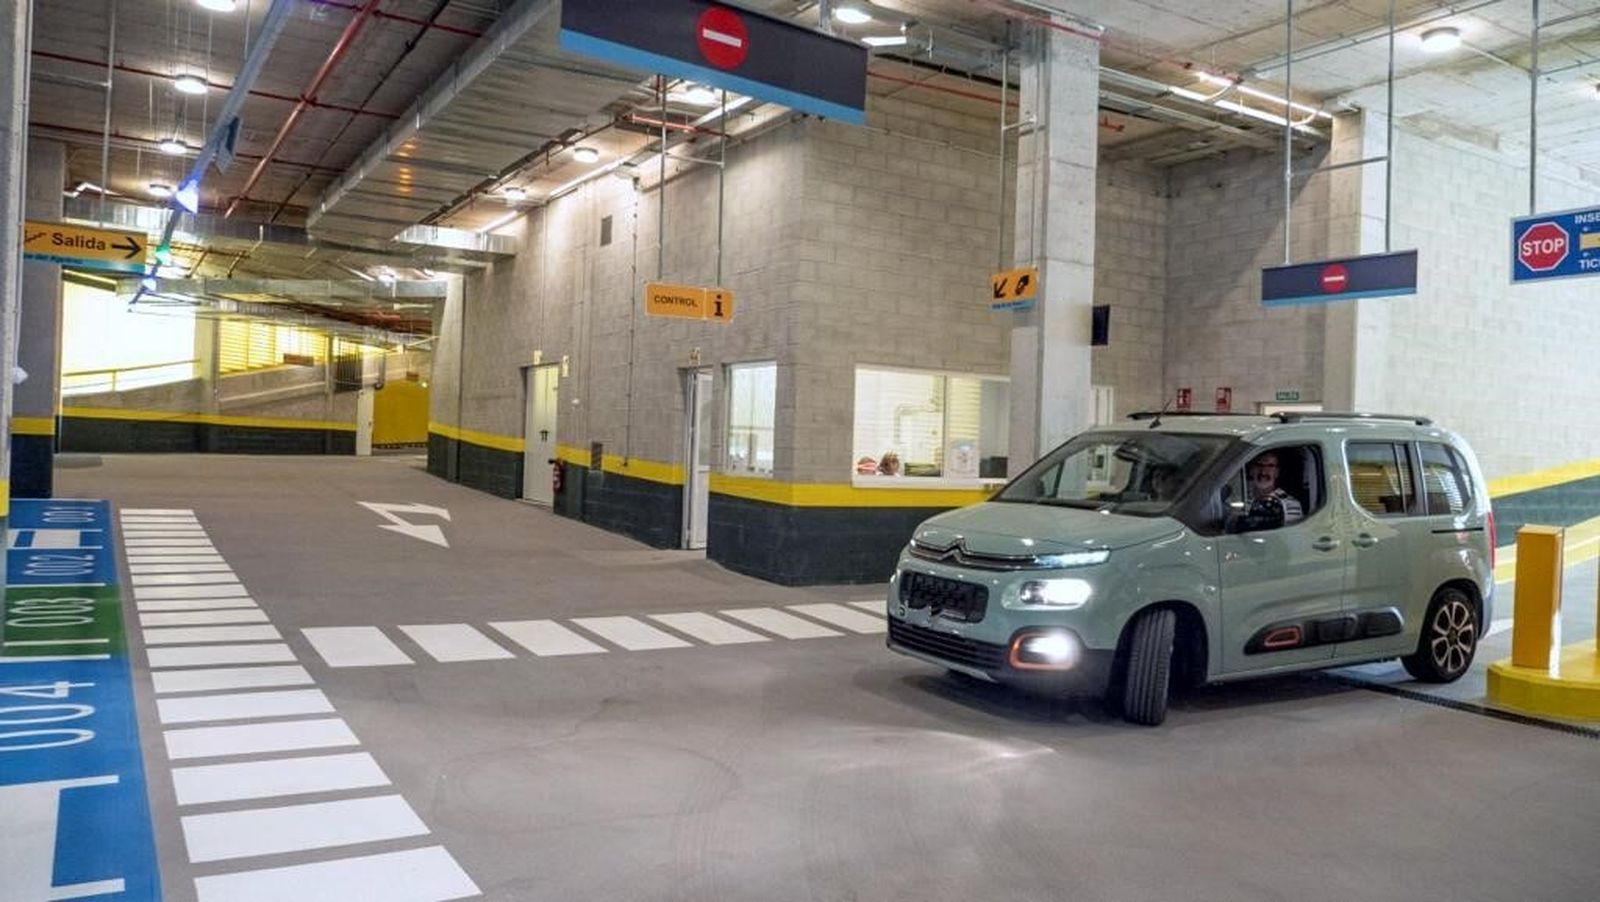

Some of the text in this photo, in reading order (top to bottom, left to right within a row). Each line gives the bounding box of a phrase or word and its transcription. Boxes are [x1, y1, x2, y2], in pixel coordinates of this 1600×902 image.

[51, 232, 106, 251] Salida
[1522, 238, 1565, 257] STOP
[1579, 258, 1600, 270] TIC
[654, 294, 698, 308] CONTROL
[23, 554, 95, 576] 002
[6, 597, 95, 627] 003
[0, 681, 96, 751] 004
